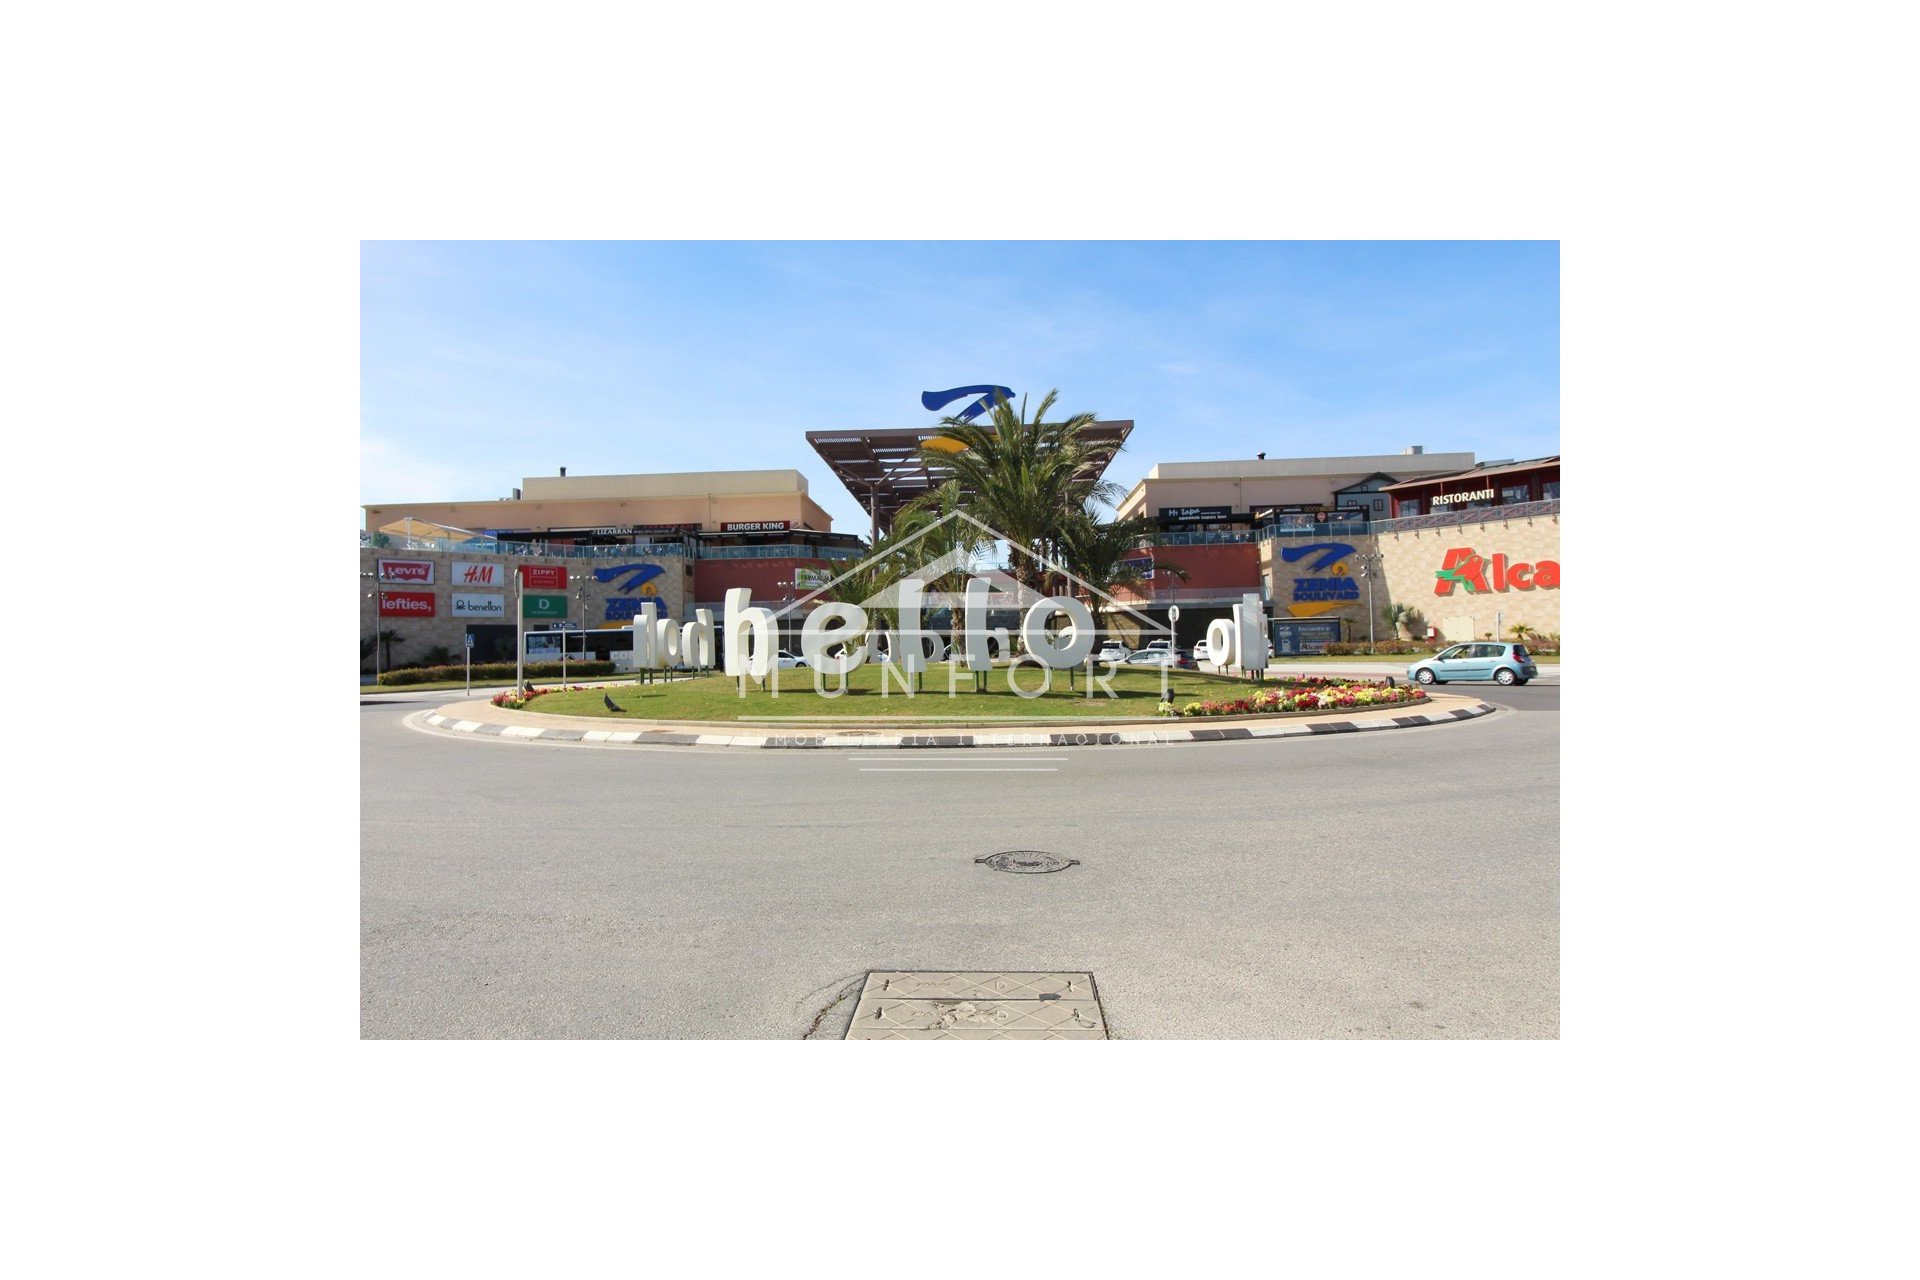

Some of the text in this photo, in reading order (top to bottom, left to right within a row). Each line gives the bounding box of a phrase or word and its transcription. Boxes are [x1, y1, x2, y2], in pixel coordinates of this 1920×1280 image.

[1432, 489, 1494, 505] RISTORANTI
[727, 522, 784, 531] BURGER KING
[1294, 577, 1359, 592] ZENIA
[1293, 591, 1360, 601] BOULEVARD
[468, 601, 502, 612] benetton
[539, 599, 550, 609] D
[724, 577, 1096, 677] hello
